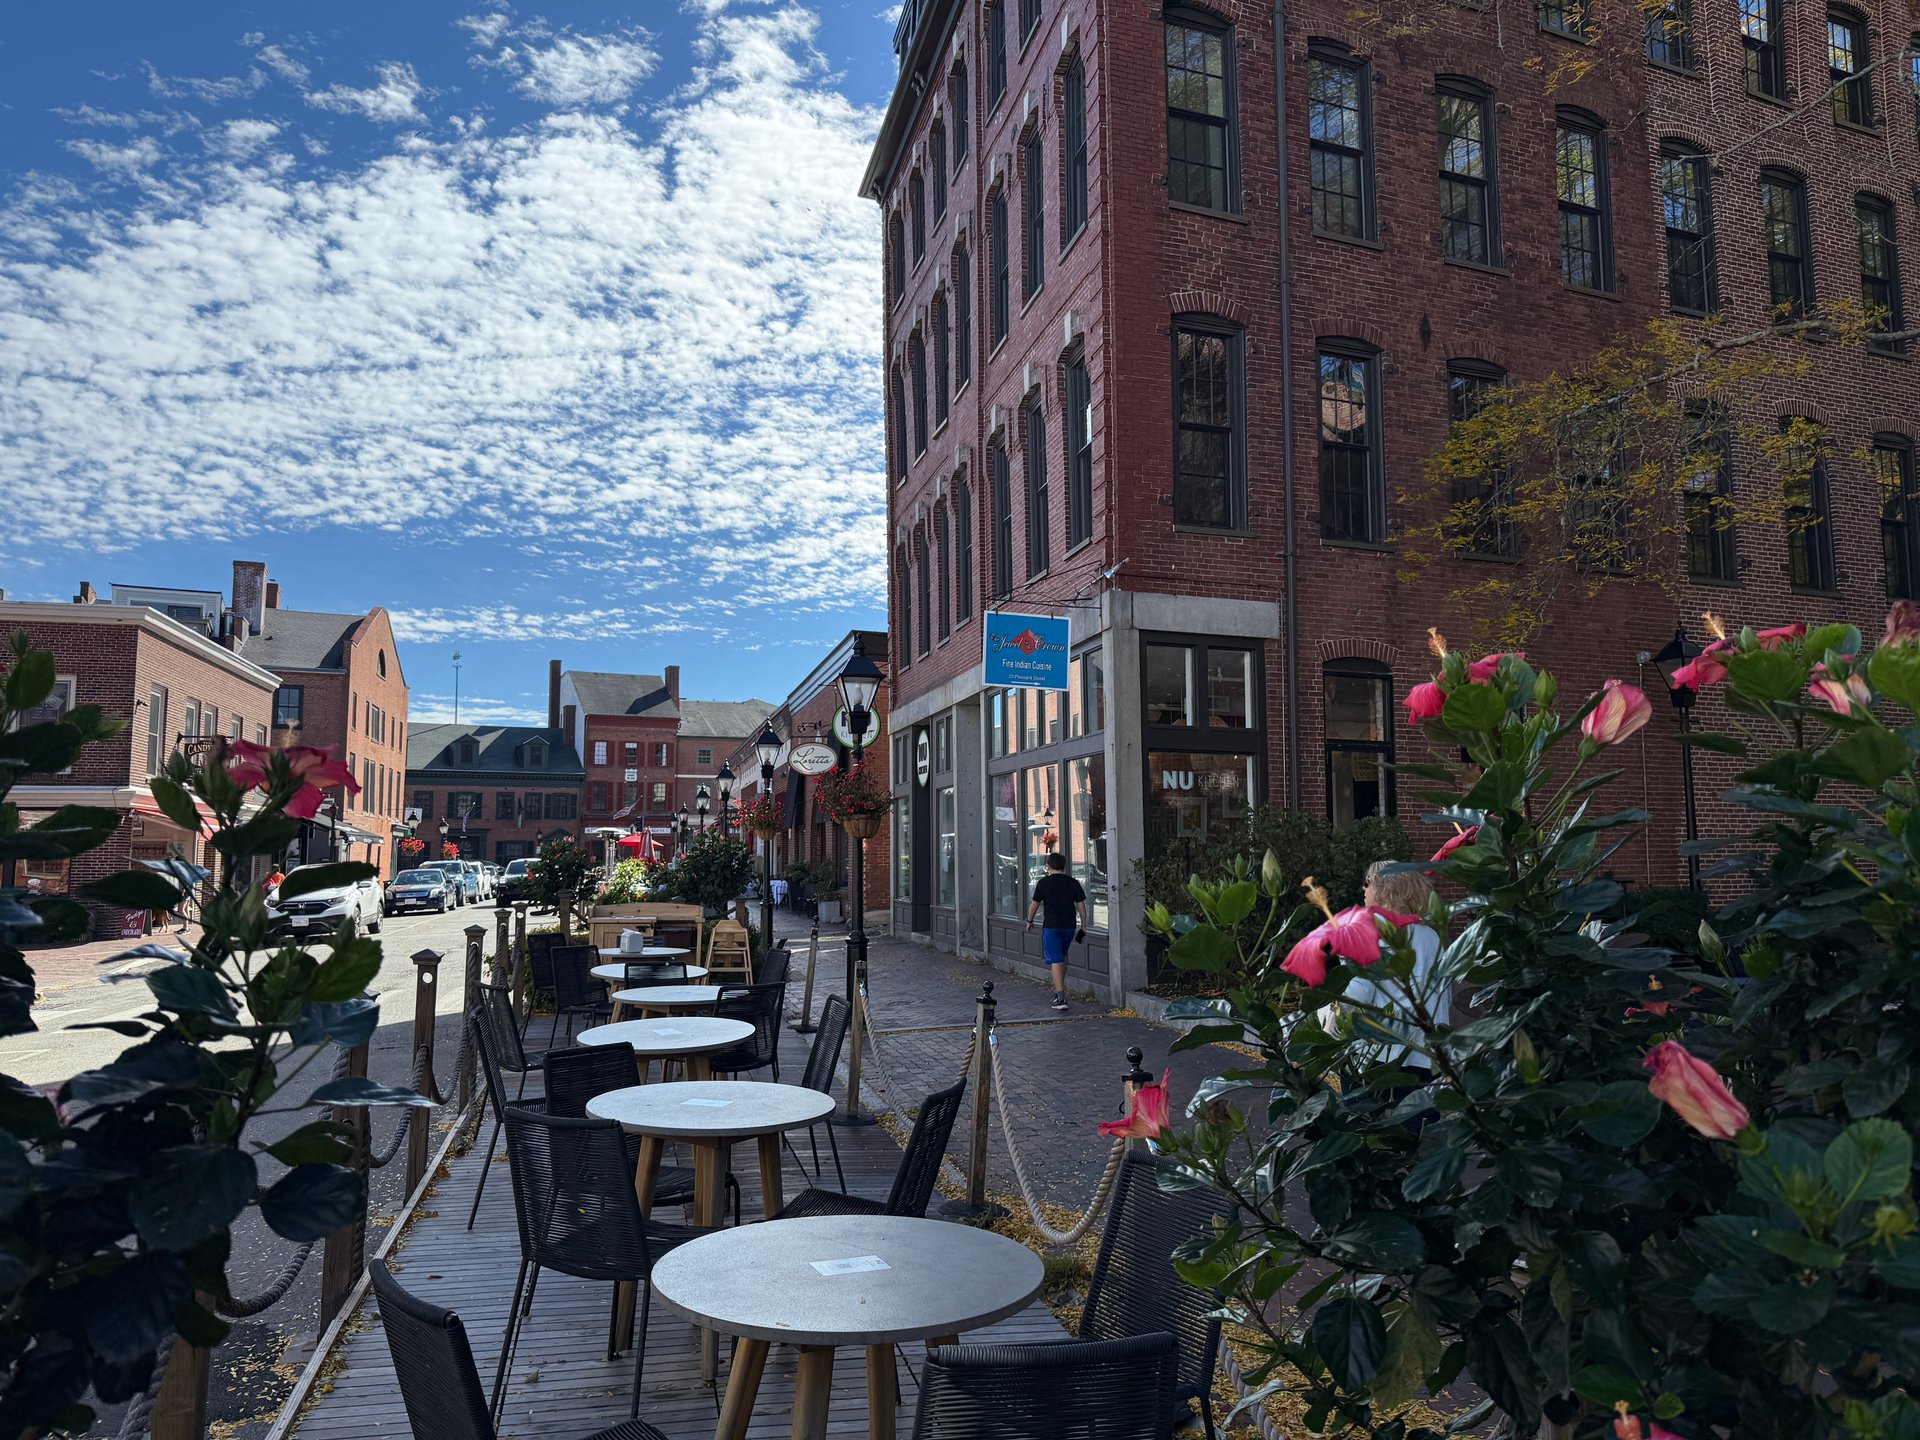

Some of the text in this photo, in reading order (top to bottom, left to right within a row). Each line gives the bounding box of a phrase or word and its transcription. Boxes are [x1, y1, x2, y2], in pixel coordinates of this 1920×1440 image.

[993, 634, 1022, 652] Jewel
[1034, 635, 1066, 652] Crown
[1002, 658, 1052, 671] Fine Indian Cuisine
[187, 744, 212, 755] CANDY
[793, 747, 833, 770] Loretta
[1162, 770, 1240, 790] NU KITCHEN
[125, 909, 143, 922] Fudge
